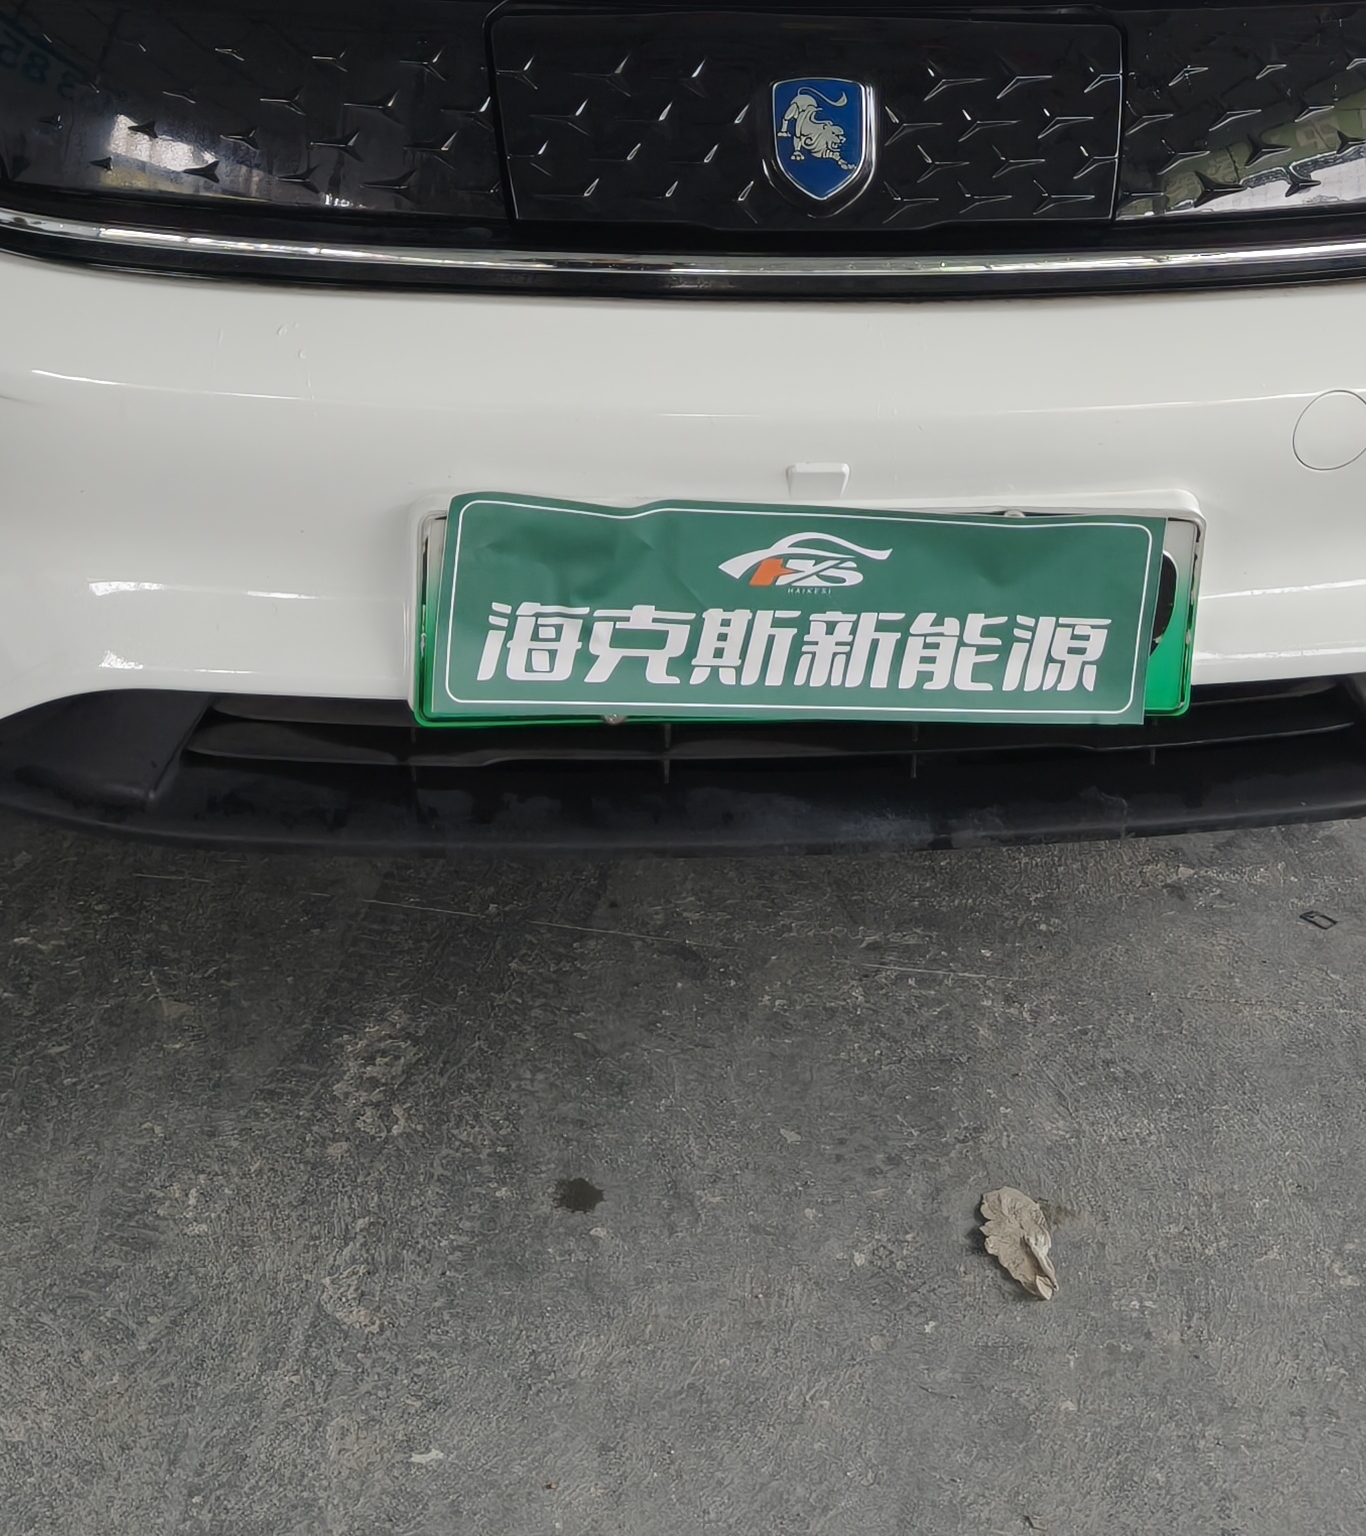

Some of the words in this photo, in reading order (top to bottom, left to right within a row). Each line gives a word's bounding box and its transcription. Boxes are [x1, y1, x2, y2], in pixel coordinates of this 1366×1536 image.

[475, 600, 1113, 694] 海克斯新能源
